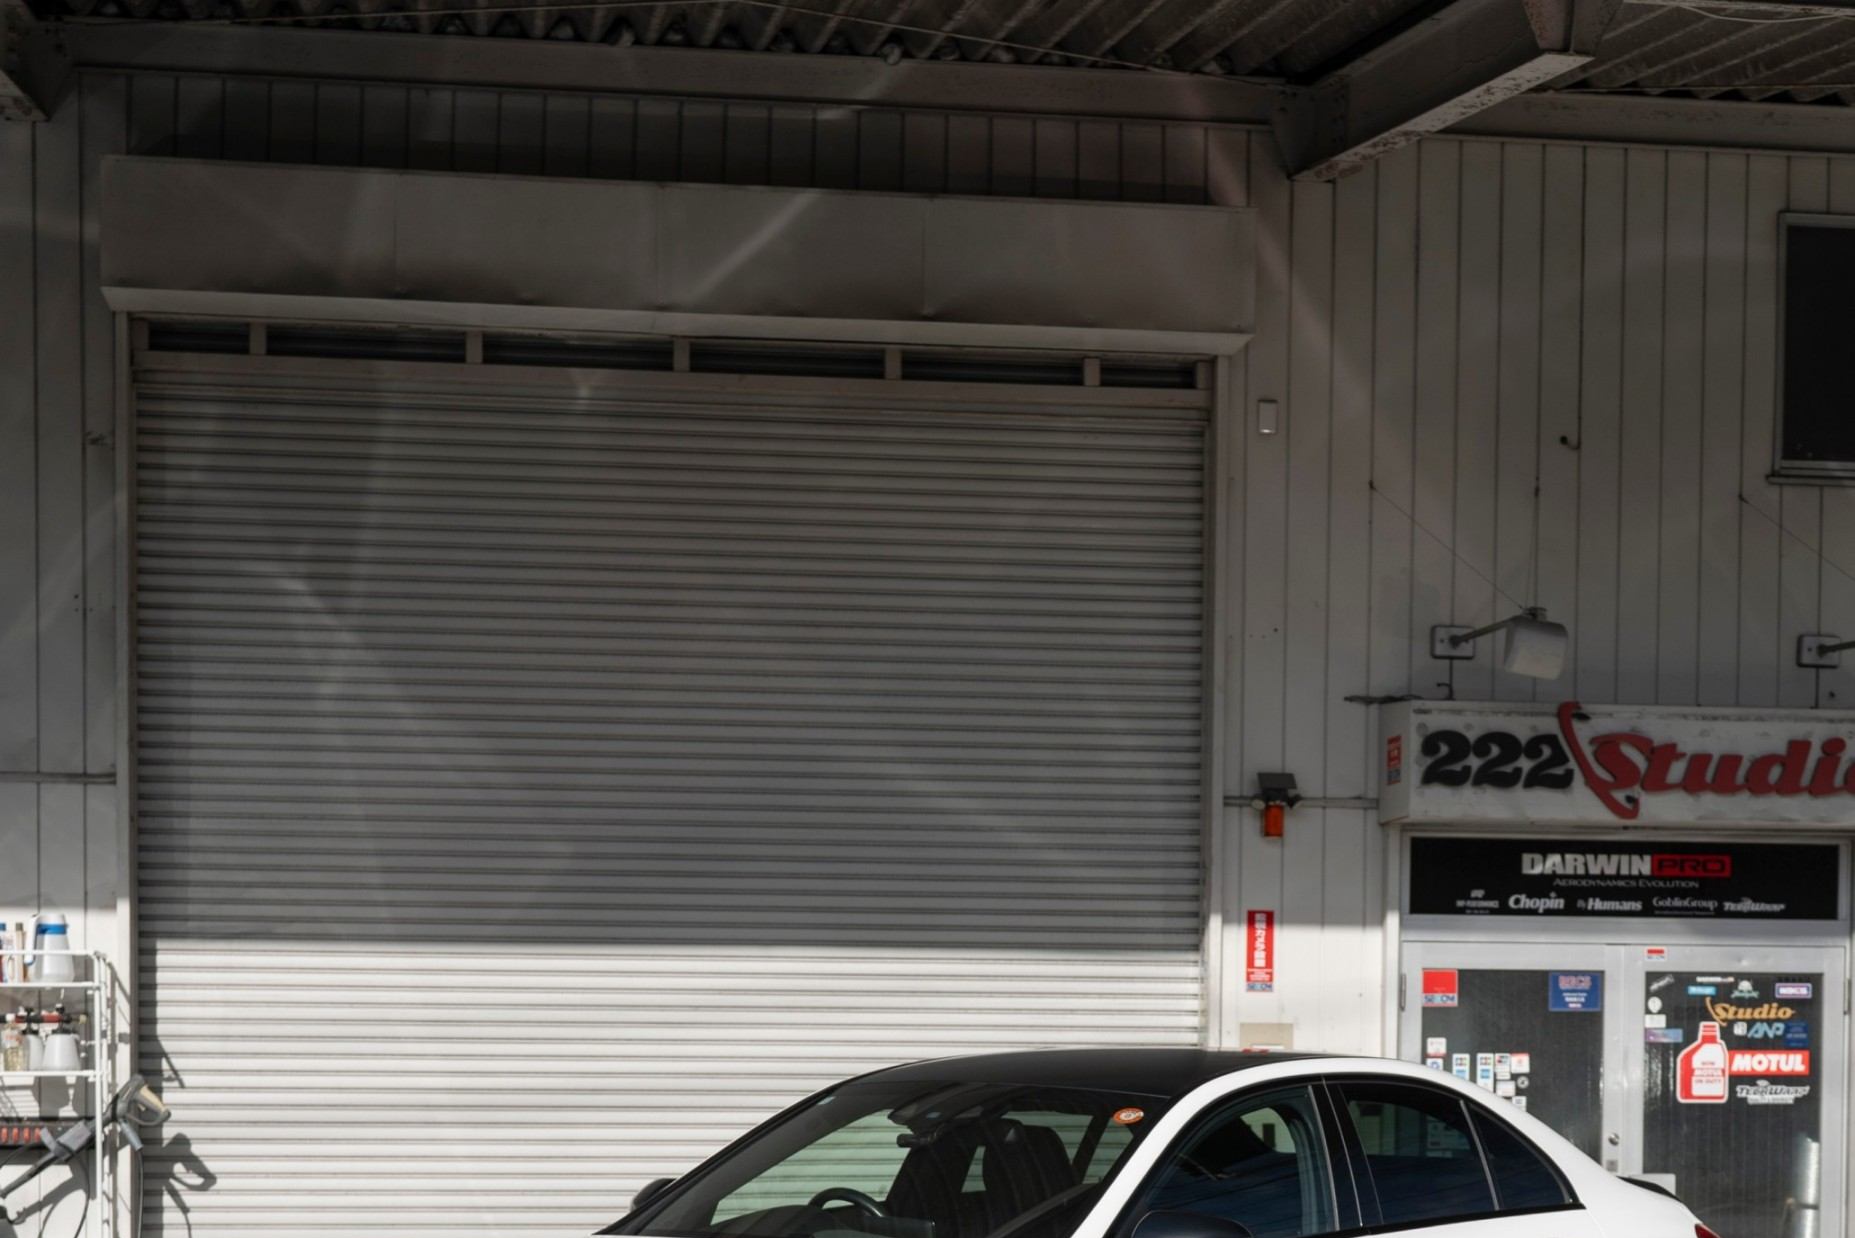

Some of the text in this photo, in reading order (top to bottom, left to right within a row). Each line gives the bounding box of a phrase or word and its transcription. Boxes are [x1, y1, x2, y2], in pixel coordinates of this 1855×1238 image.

[1421, 729, 1575, 789] 222
[1521, 853, 1729, 877] DARWIN PRO
[1508, 892, 1565, 913] Chopin
[1587, 898, 1642, 911] Humans
[1709, 999, 1795, 1024] Studio
[1731, 1053, 1805, 1072] MOTUL
